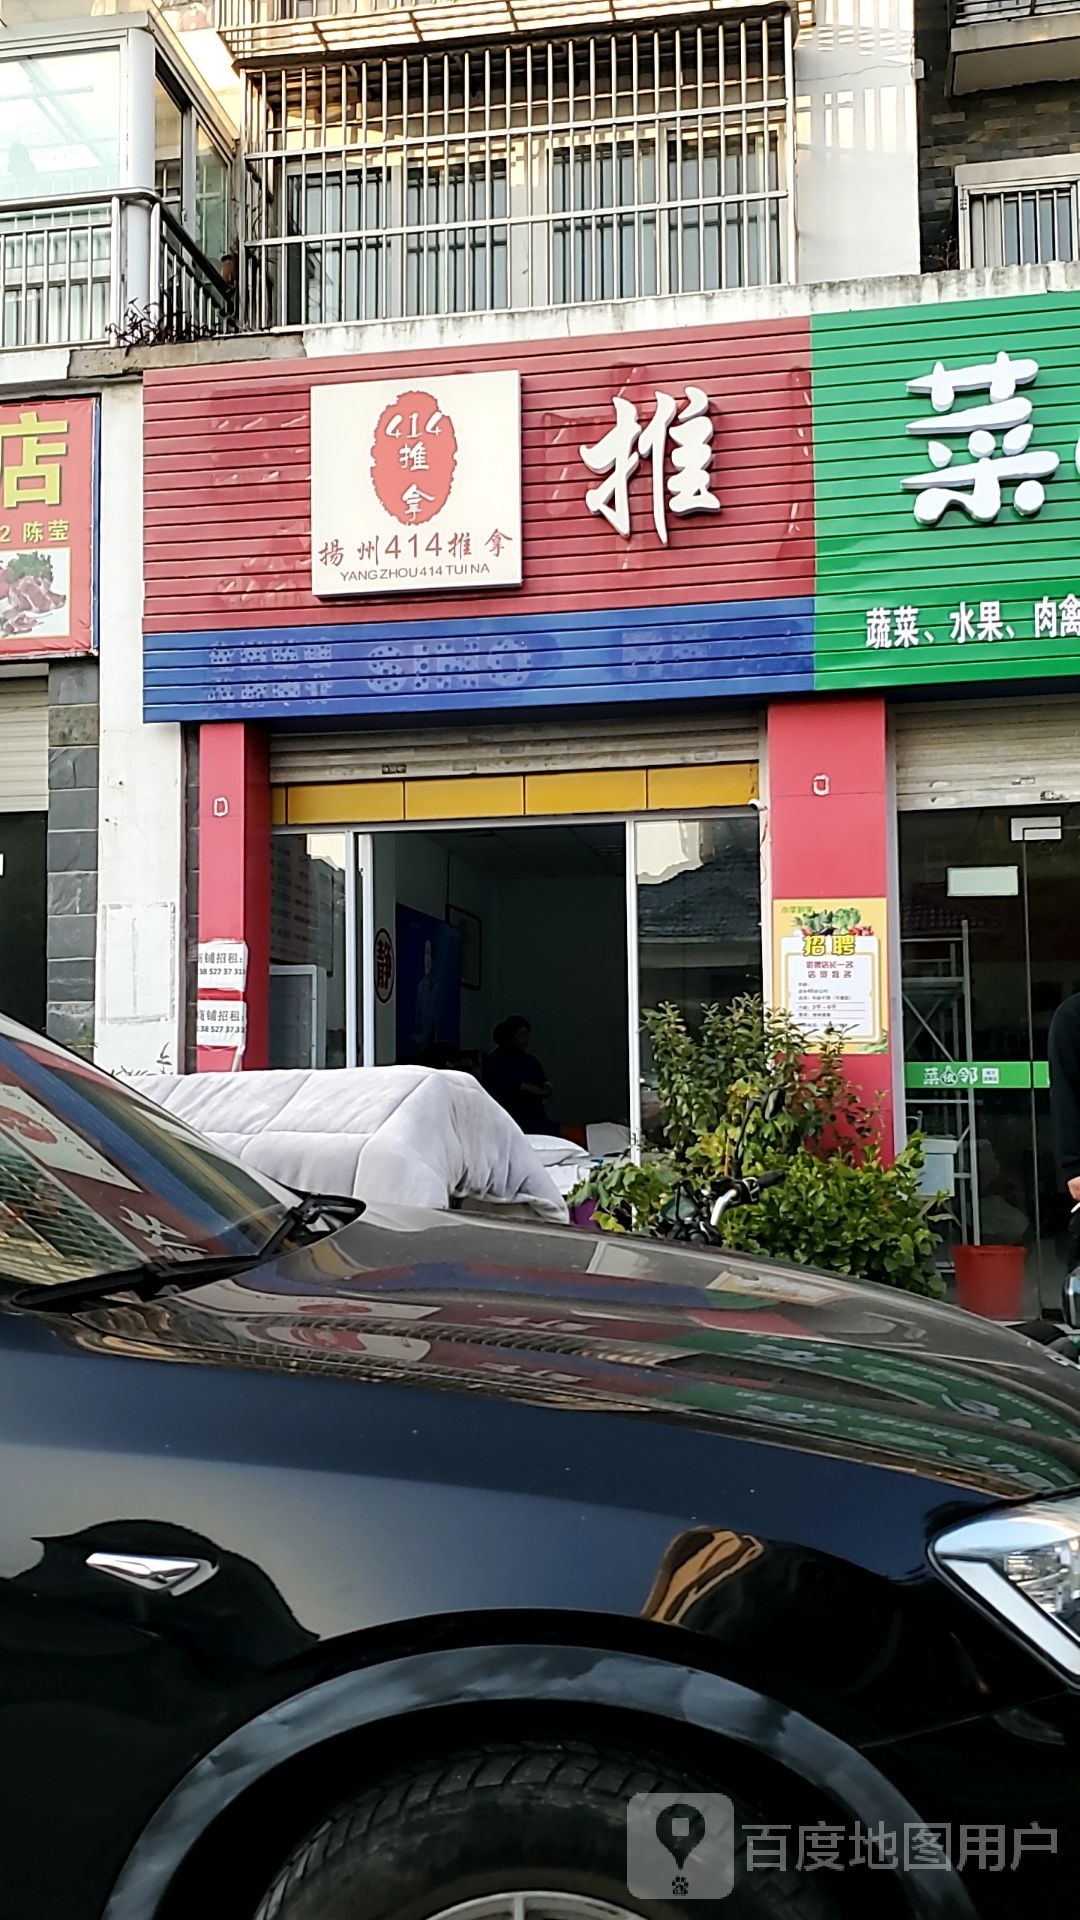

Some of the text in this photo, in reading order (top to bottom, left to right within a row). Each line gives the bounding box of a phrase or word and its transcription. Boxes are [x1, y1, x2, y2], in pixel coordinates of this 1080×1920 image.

[385, 411, 446, 439] 414
[900, 351, 1060, 524] 菜
[0, 410, 68, 509] 店
[580, 386, 721, 547] 推
[399, 441, 436, 521] 推拿
[23, 519, 69, 543] 陈莹
[802, 934, 855, 957] 招聘
[209, 968, 222, 976] 527
[223, 968, 232, 976] 37
[210, 1025, 224, 1034] 527
[225, 1025, 235, 1034] 37
